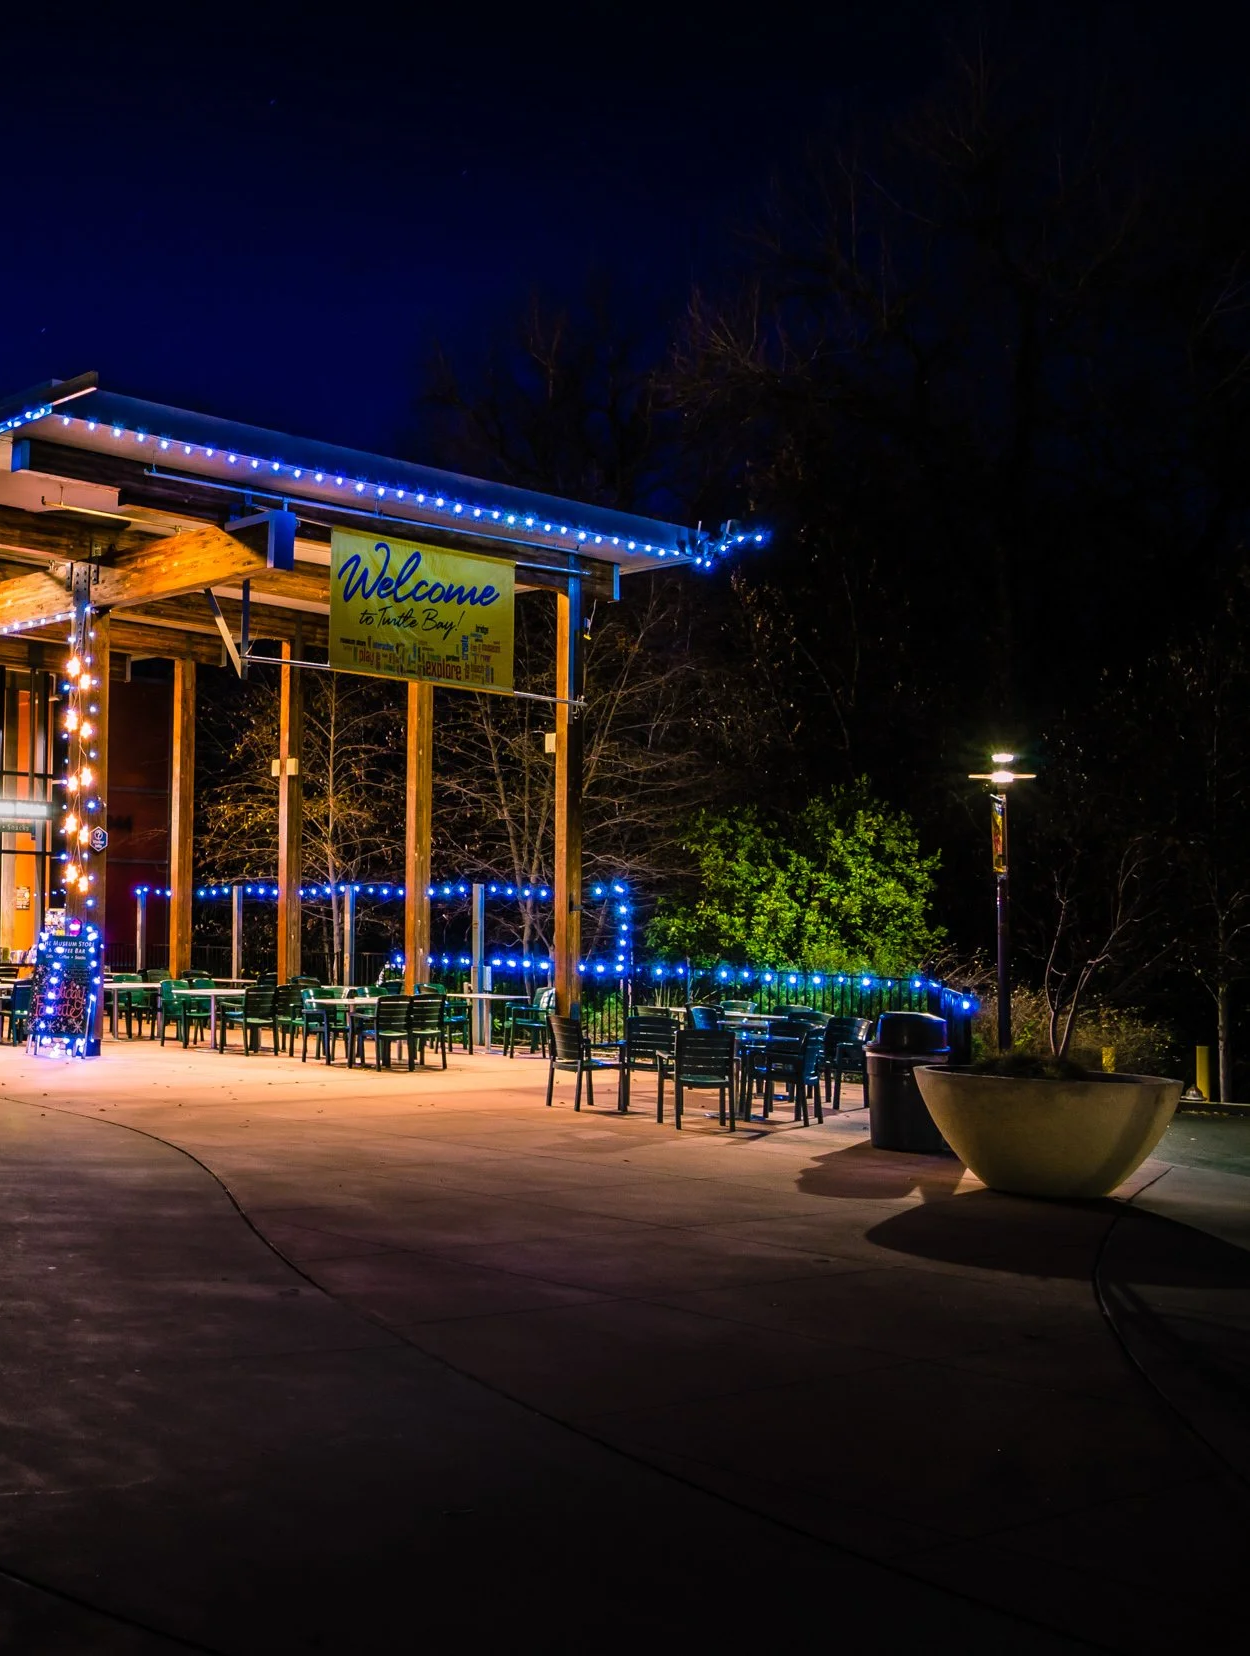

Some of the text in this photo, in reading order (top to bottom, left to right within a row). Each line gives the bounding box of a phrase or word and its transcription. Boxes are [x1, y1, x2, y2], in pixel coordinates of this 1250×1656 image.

[338, 542, 500, 607] Welcome
[359, 609, 377, 626] to
[377, 606, 418, 628] Turtle
[422, 608, 465, 640] Bay!
[359, 648, 374, 665] play
[426, 658, 461, 680] explore
